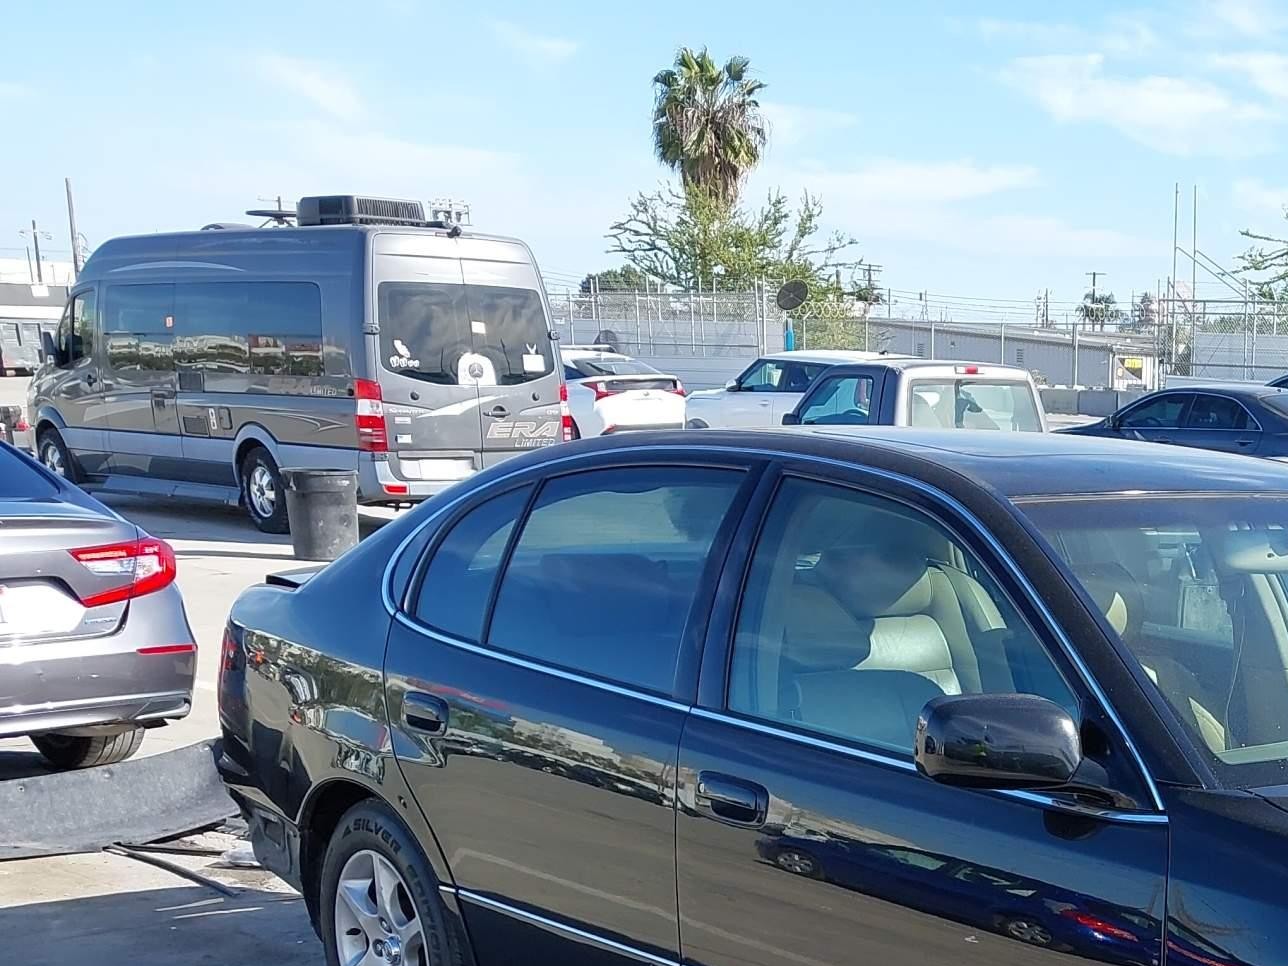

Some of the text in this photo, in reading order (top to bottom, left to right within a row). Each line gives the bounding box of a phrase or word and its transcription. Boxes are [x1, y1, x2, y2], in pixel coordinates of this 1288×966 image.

[487, 421, 560, 439] ERA
[514, 439, 556, 448] LIMITED
[353, 818, 402, 854] SILVER
